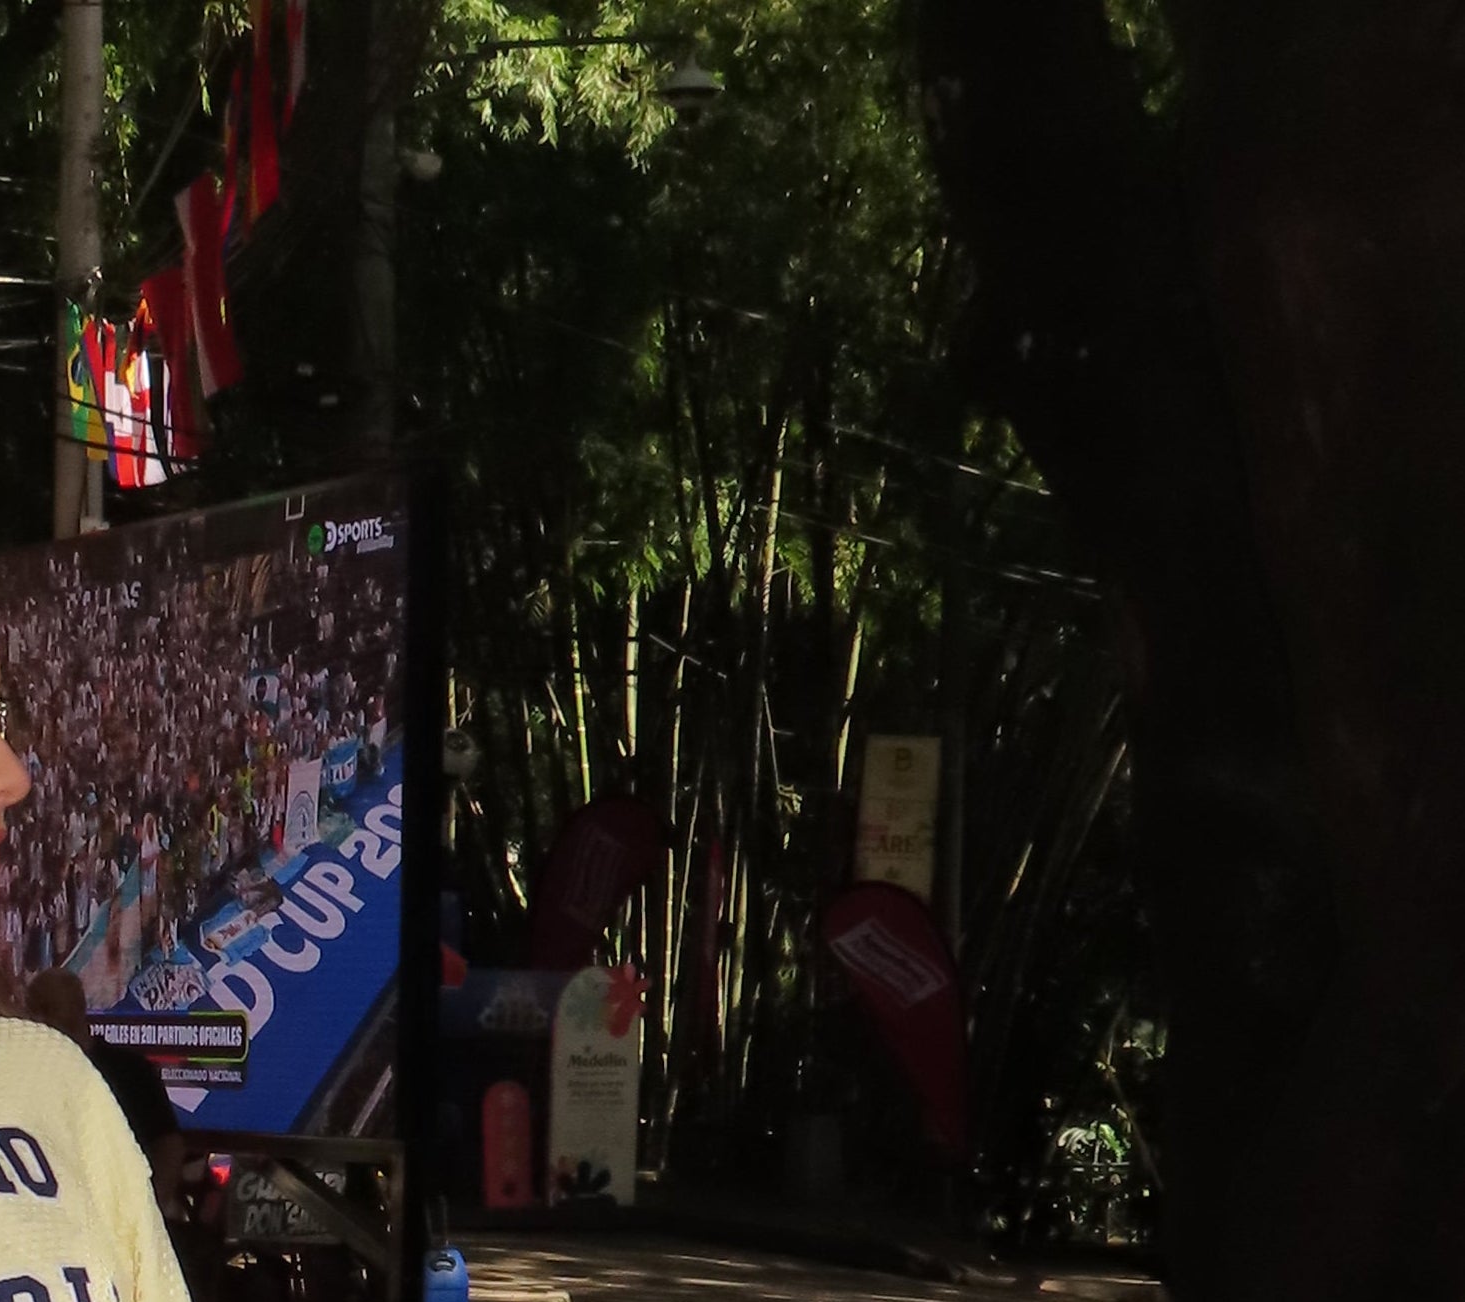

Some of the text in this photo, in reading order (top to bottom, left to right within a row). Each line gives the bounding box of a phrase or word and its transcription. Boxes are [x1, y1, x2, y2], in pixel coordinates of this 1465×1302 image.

[261, 862, 365, 972] CUP
[338, 783, 402, 880] 20
[130, 1024, 140, 1045] EN
[141, 1025, 157, 1045] 201
[157, 1025, 198, 1046] PARTIDOS
[199, 1026, 243, 1047] OFICIALES
[161, 1068, 243, 1082] SELECCIONADO NACIONAL
